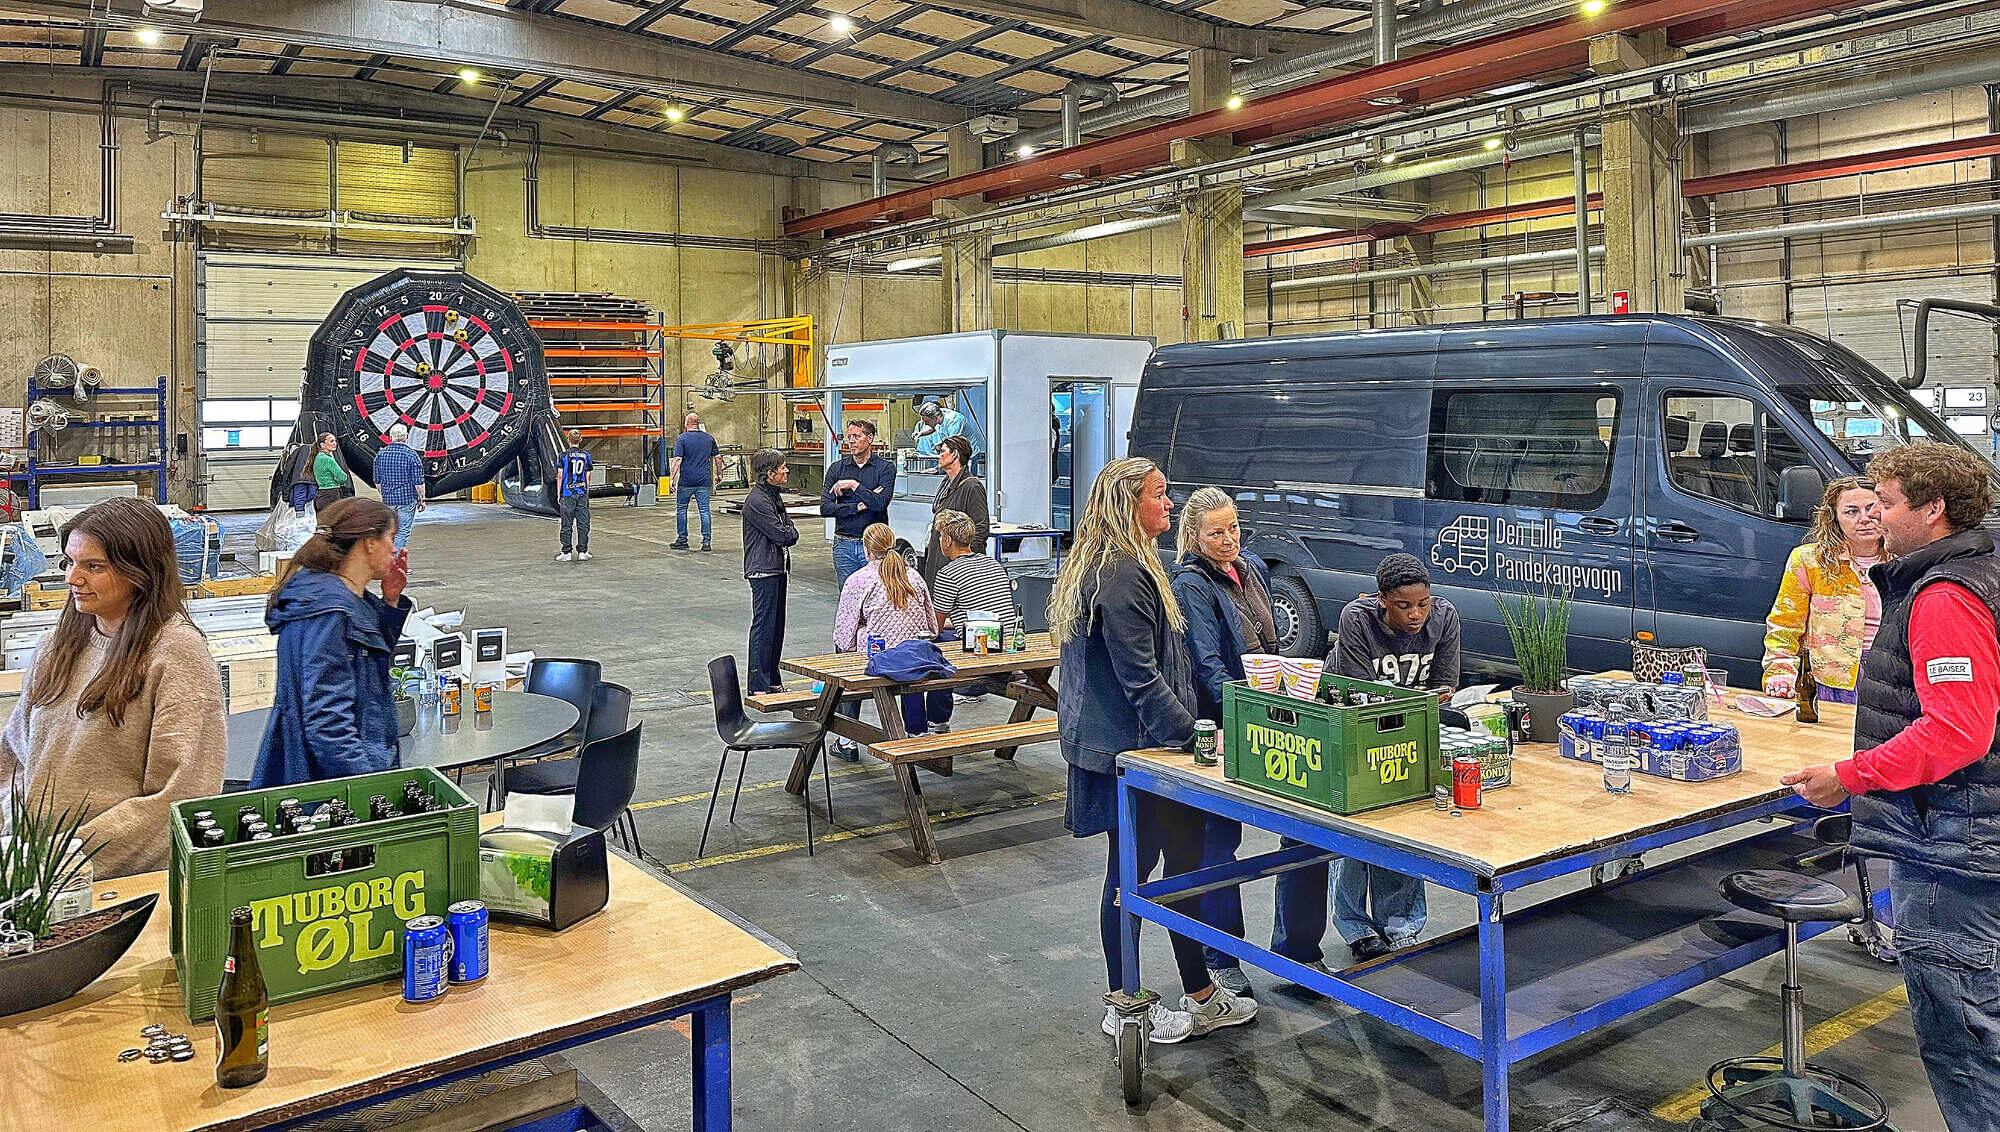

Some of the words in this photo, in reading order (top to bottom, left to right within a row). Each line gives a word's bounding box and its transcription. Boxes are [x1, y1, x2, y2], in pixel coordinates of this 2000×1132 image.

[401, 295, 409, 305] 5
[429, 292, 442, 300] 20
[458, 295, 464, 304] 1
[374, 305, 390, 318] 12
[482, 308, 495, 320] 18
[354, 329, 364, 338] 9
[501, 327, 511, 336] 4
[342, 348, 354, 361] 14
[514, 350, 525, 363] 13
[337, 378, 349, 389] 11
[1968, 392, 1983, 401] 23
[342, 403, 352, 412] 8
[514, 401, 525, 413] 10
[356, 429, 370, 442] 16
[500, 424, 513, 437] 15
[480, 447, 489, 457] 2
[431, 461, 439, 471] 3
[455, 456, 467, 468] 17
[571, 459, 584, 475] 10
[1495, 517, 1525, 546] Den
[1530, 518, 1562, 549] Lille
[1495, 552, 1622, 598] Pandekagevogn
[1937, 665, 1966, 673] BAISER
[1246, 723, 1322, 771] TUBORG
[1366, 740, 1418, 771] TUBORG
[1574, 739, 1650, 771] PESI
[1264, 748, 1308, 788] ØL
[1380, 757, 1409, 785] ØL
[249, 870, 426, 949] TUBORG
[295, 910, 395, 975] ØL
